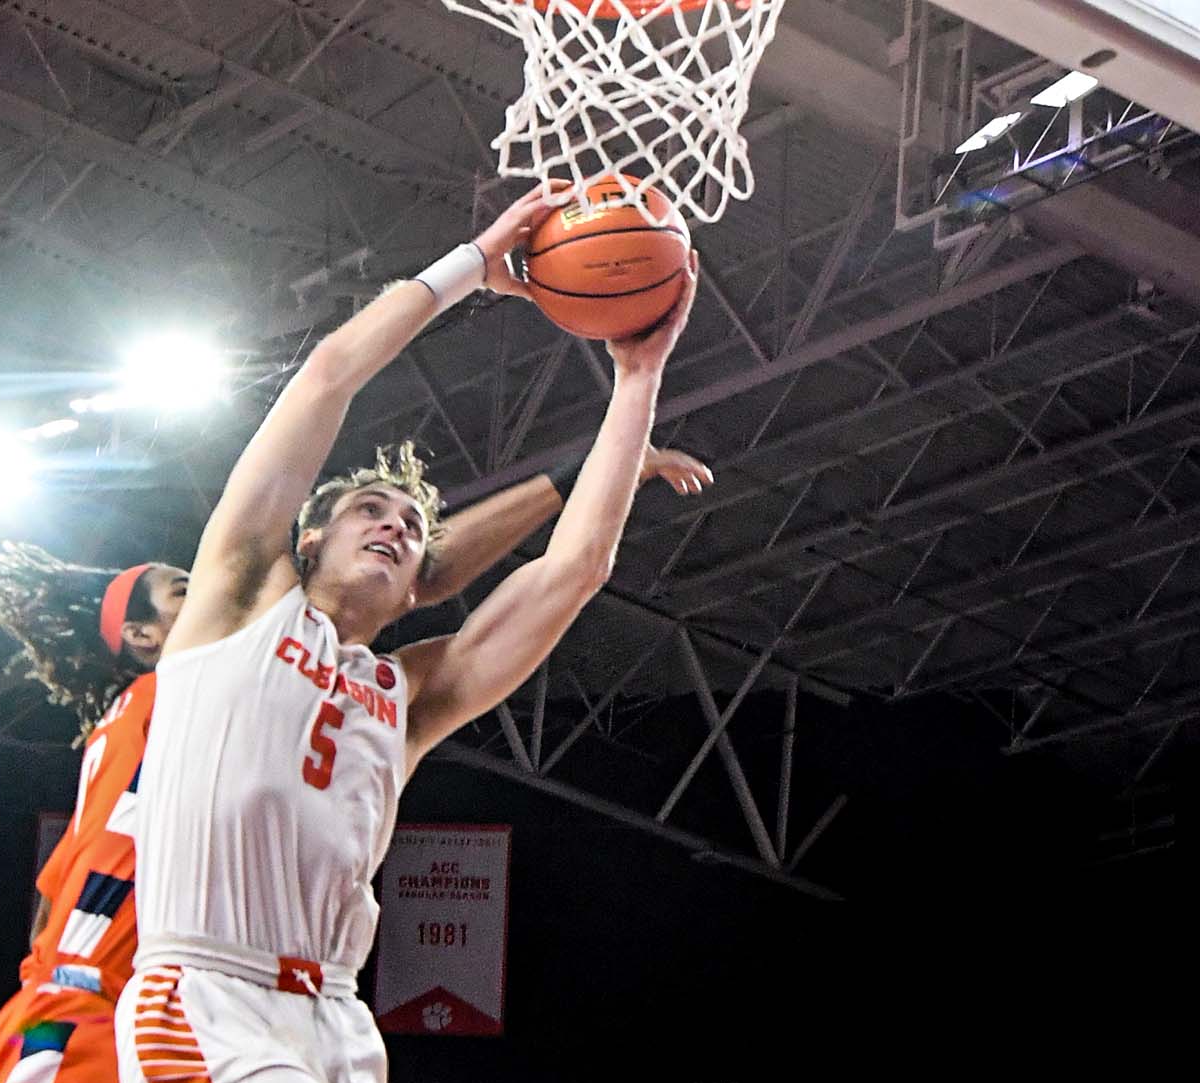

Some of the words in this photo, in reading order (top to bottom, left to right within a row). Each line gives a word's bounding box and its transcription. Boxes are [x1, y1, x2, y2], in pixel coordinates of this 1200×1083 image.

[302, 700, 345, 790] 5
[430, 861, 460, 874] ACC
[398, 874, 491, 890] CHAMPIONS
[417, 922, 468, 947] 1981
